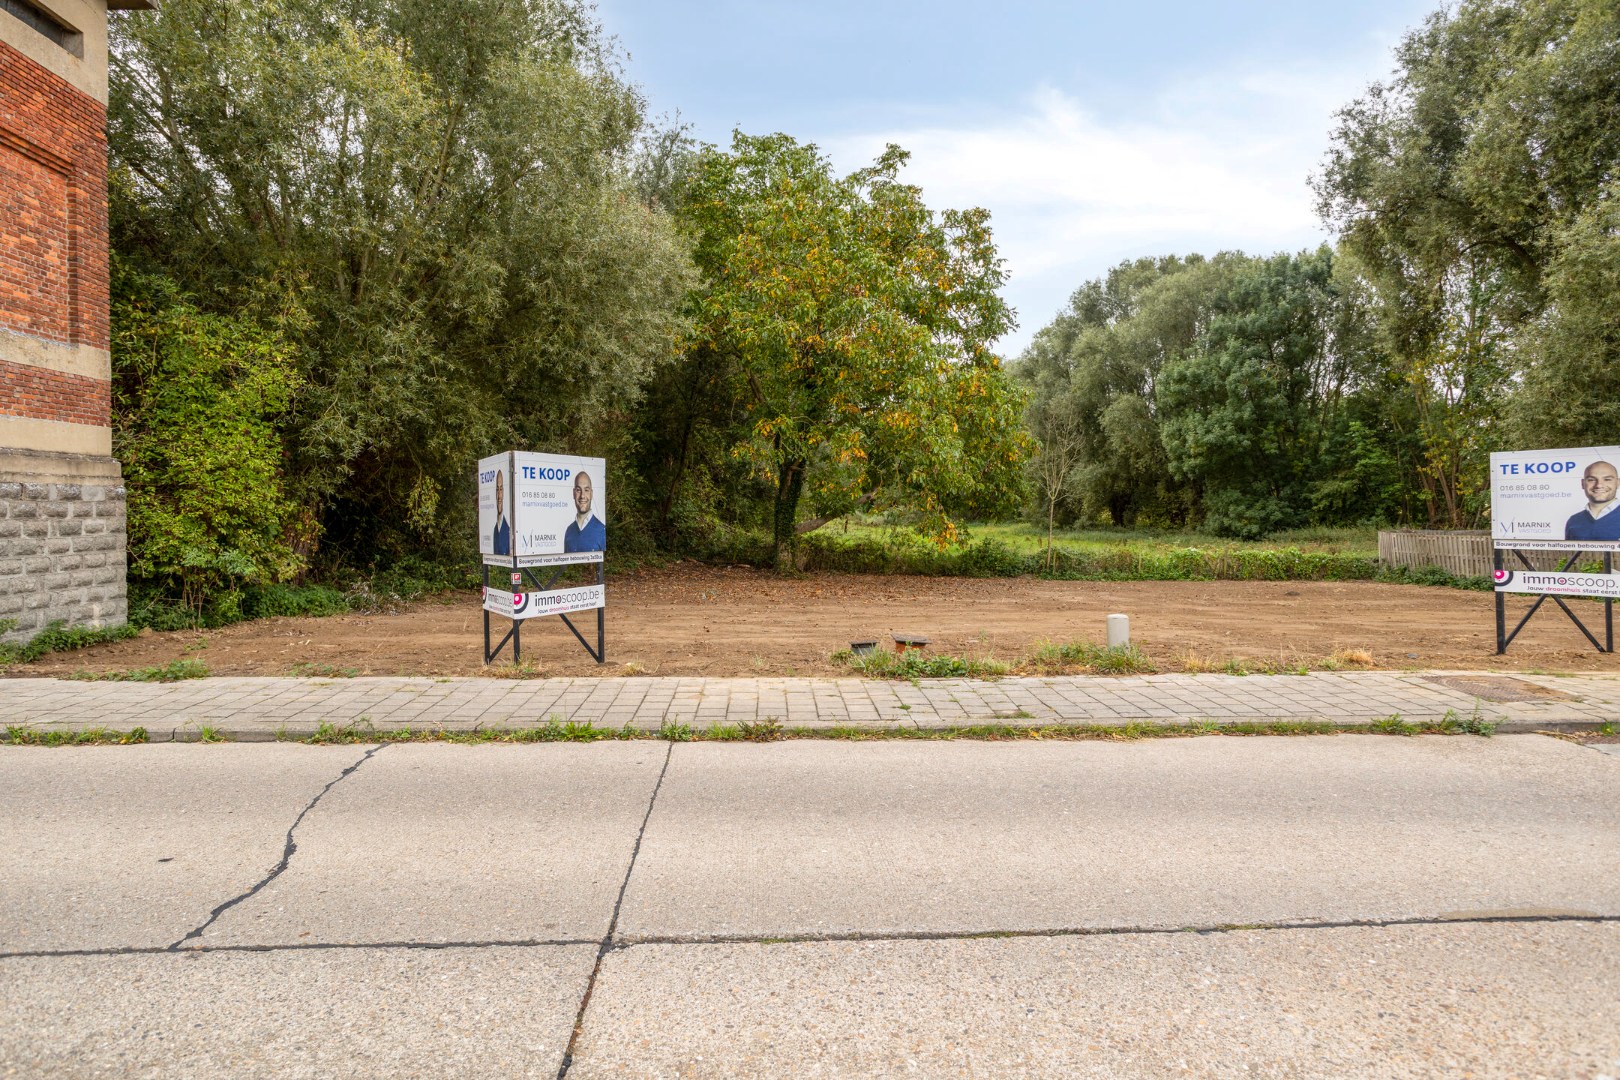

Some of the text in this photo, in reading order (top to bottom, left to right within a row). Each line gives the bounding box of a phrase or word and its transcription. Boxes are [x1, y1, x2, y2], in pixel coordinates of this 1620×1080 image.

[522, 466, 570, 480] TE KOOP
[1500, 462, 1576, 474] TE KOOP
[535, 589, 599, 606] immoscoop.be
